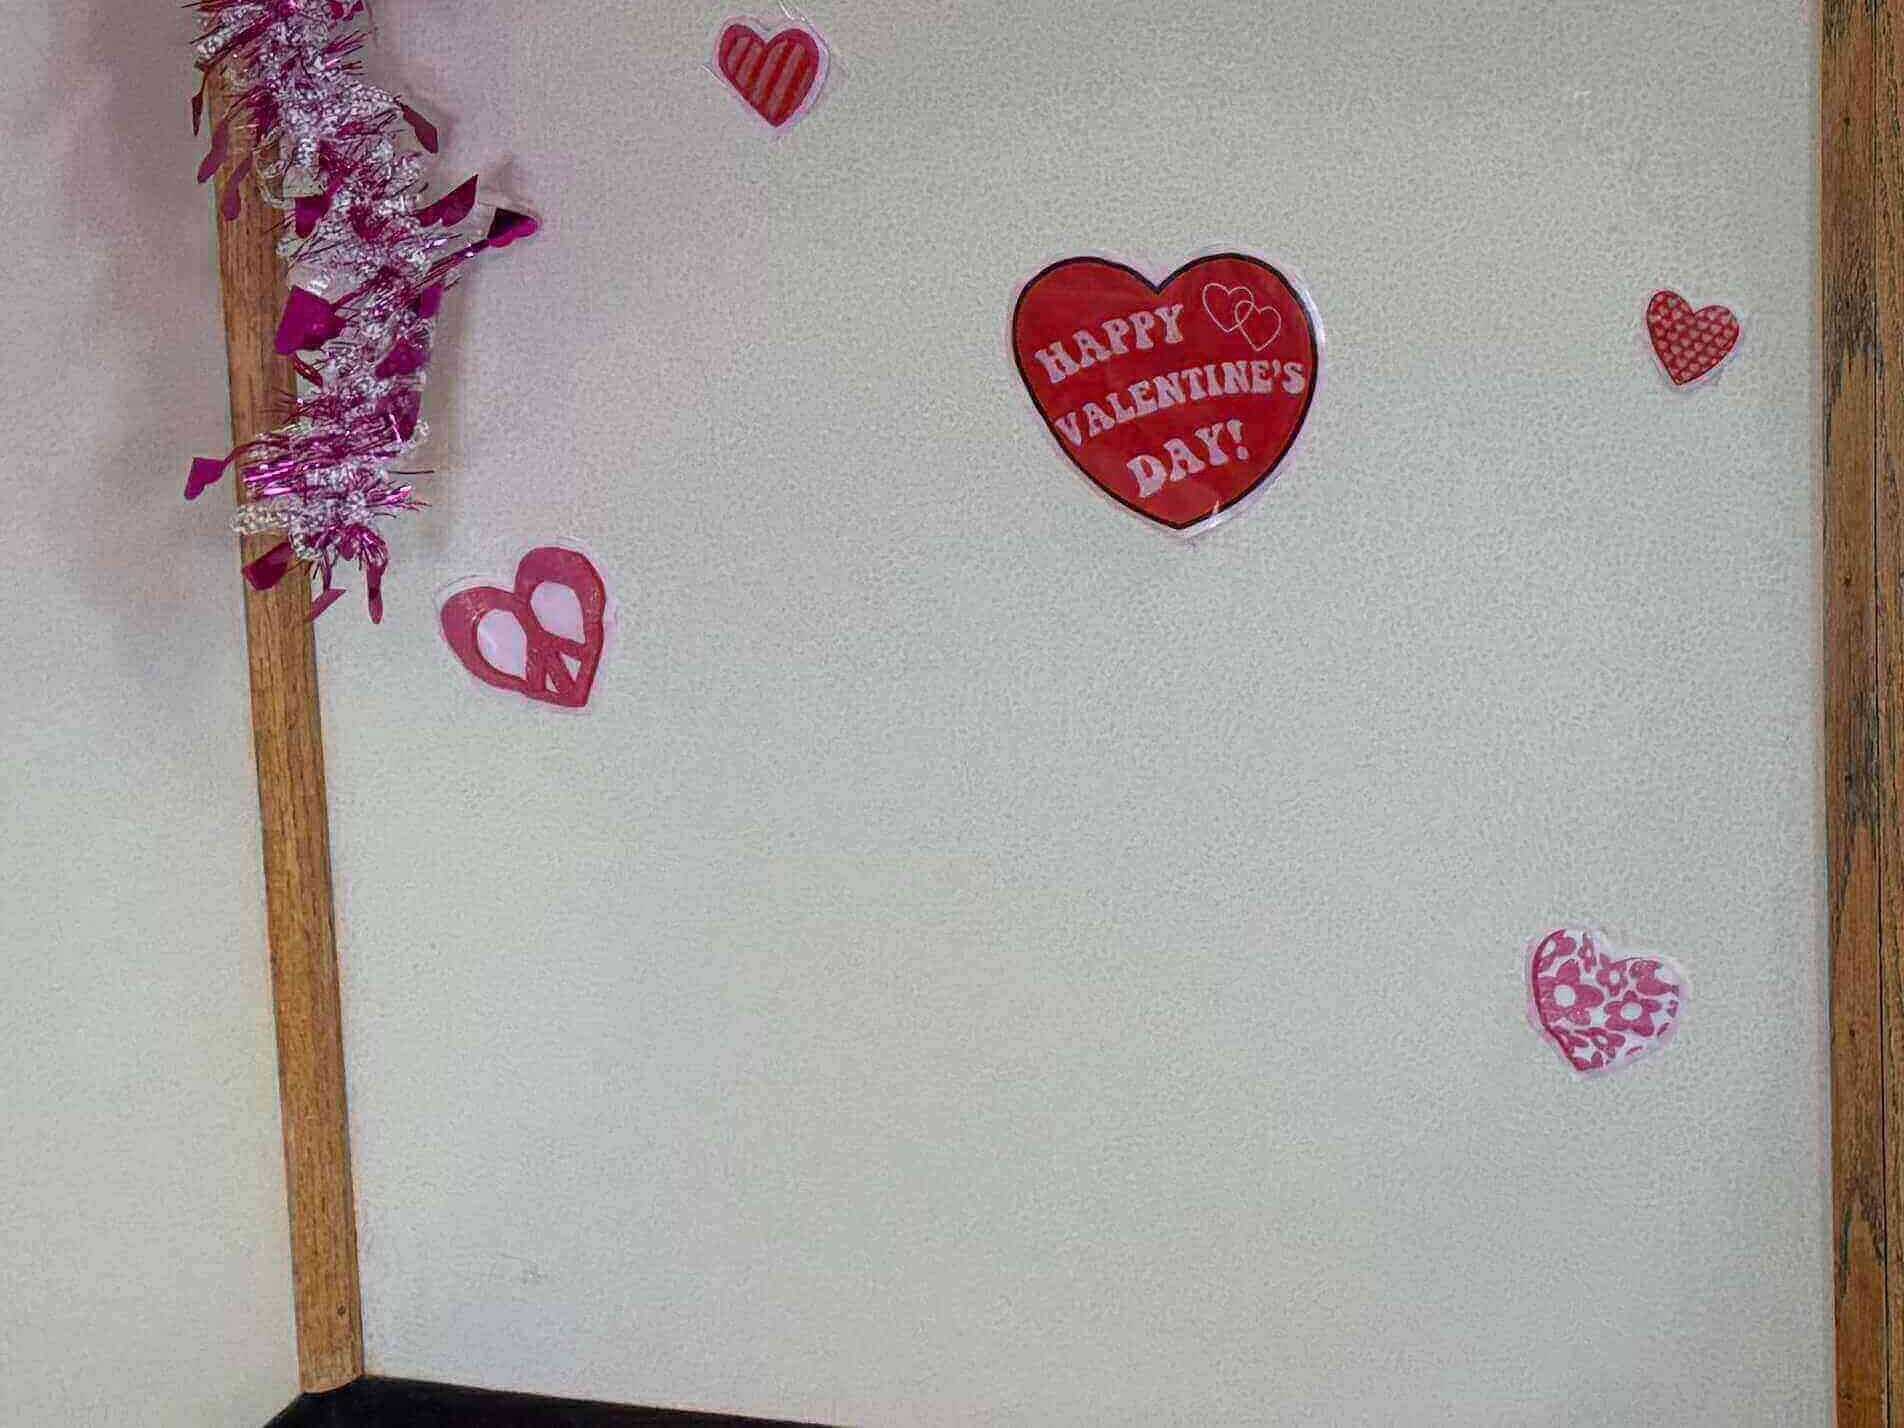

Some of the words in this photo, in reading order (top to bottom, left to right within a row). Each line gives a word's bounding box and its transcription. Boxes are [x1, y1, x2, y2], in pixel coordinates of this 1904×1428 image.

[1034, 303, 1185, 385] HAPPY
[1053, 359, 1306, 447] VALENTINE'S
[1127, 418, 1249, 498] DAY!
